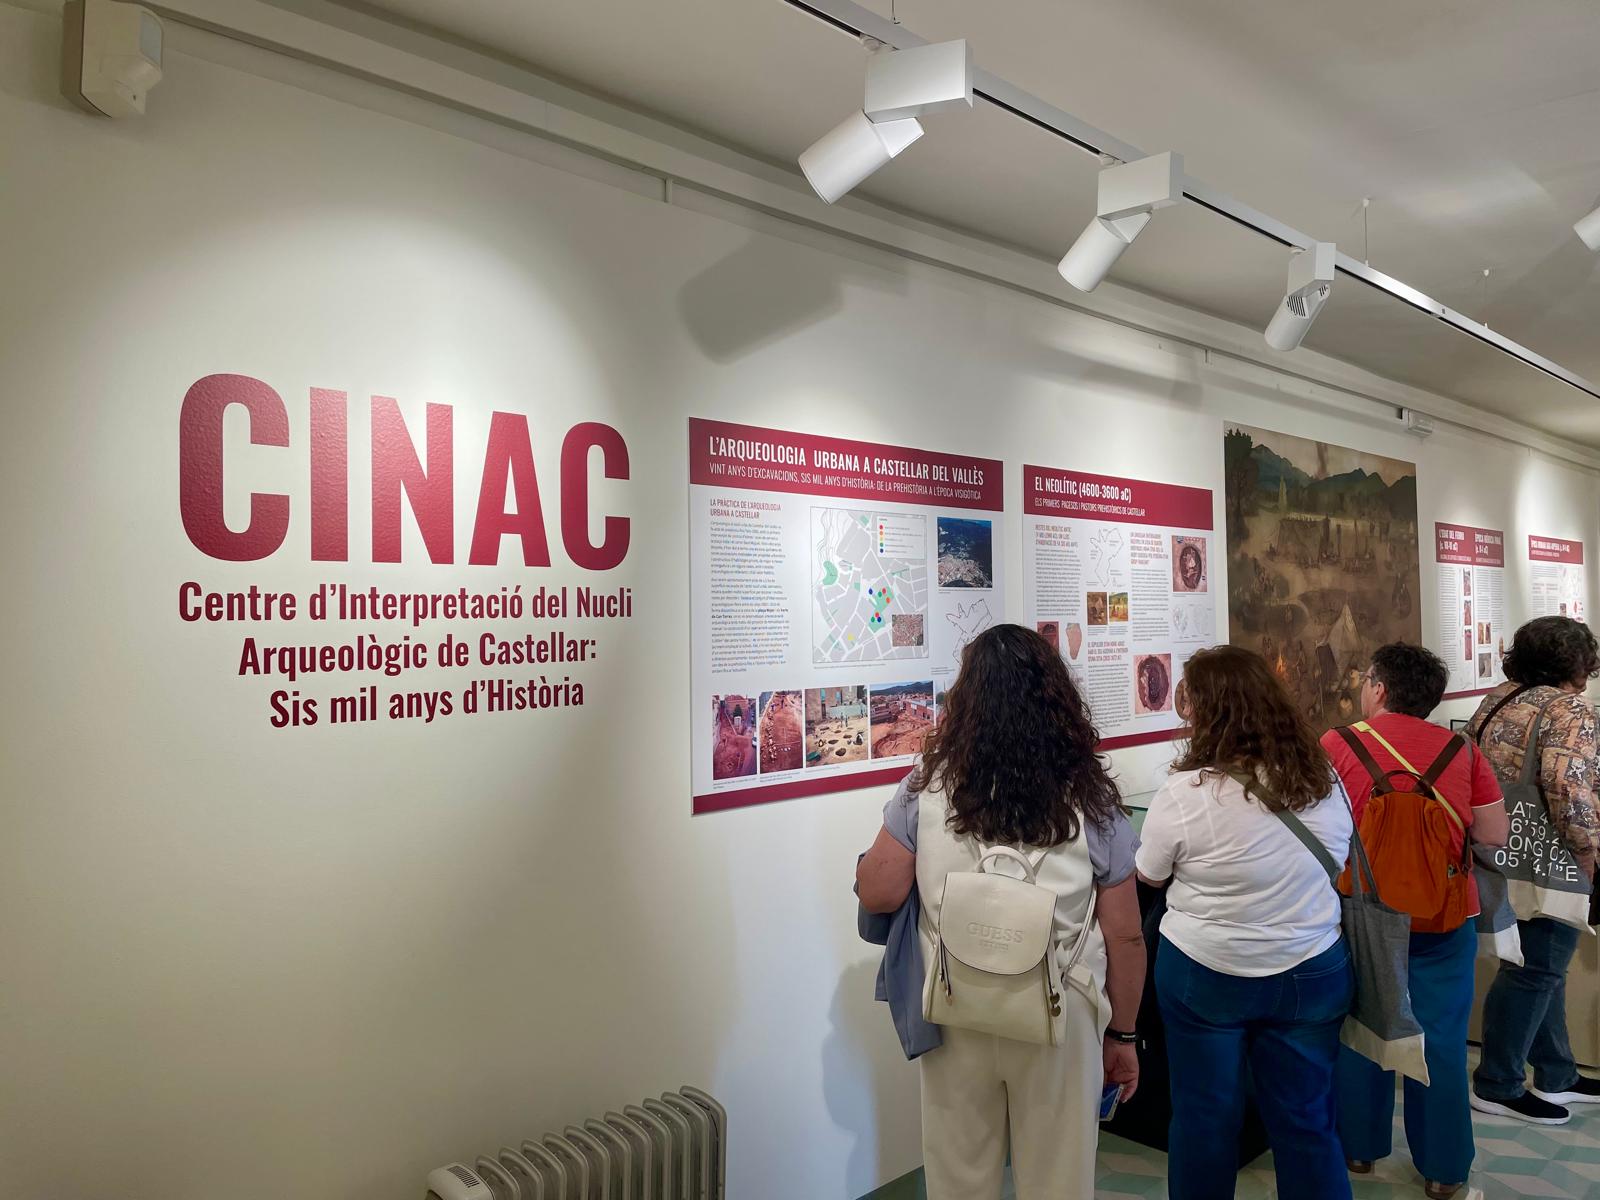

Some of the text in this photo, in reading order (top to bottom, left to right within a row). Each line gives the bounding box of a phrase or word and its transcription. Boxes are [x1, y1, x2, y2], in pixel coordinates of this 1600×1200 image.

[179, 373, 630, 571] CINAC
[709, 436, 984, 486] L'ARQUEOLOGIA URBANA A CASTELLAR DEL VALLÈS
[709, 463, 726, 475] VINT
[727, 465, 746, 478] ANYS
[801, 473, 811, 484] SIS
[812, 474, 824, 485] MIL
[825, 476, 841, 487] ANYS
[877, 481, 885, 491] DE
[885, 482, 893, 492] LA
[929, 486, 933, 496] A
[1035, 476, 1132, 504] EL NEOLÍTIC (4600-3600 aC)
[178, 581, 632, 627] Centre d'Interpretació del Nucli
[238, 631, 596, 682] Arqueològic de Castellar:
[270, 677, 584, 728] Sis mil anys d'Història
[966, 922, 1025, 944] GUESS
